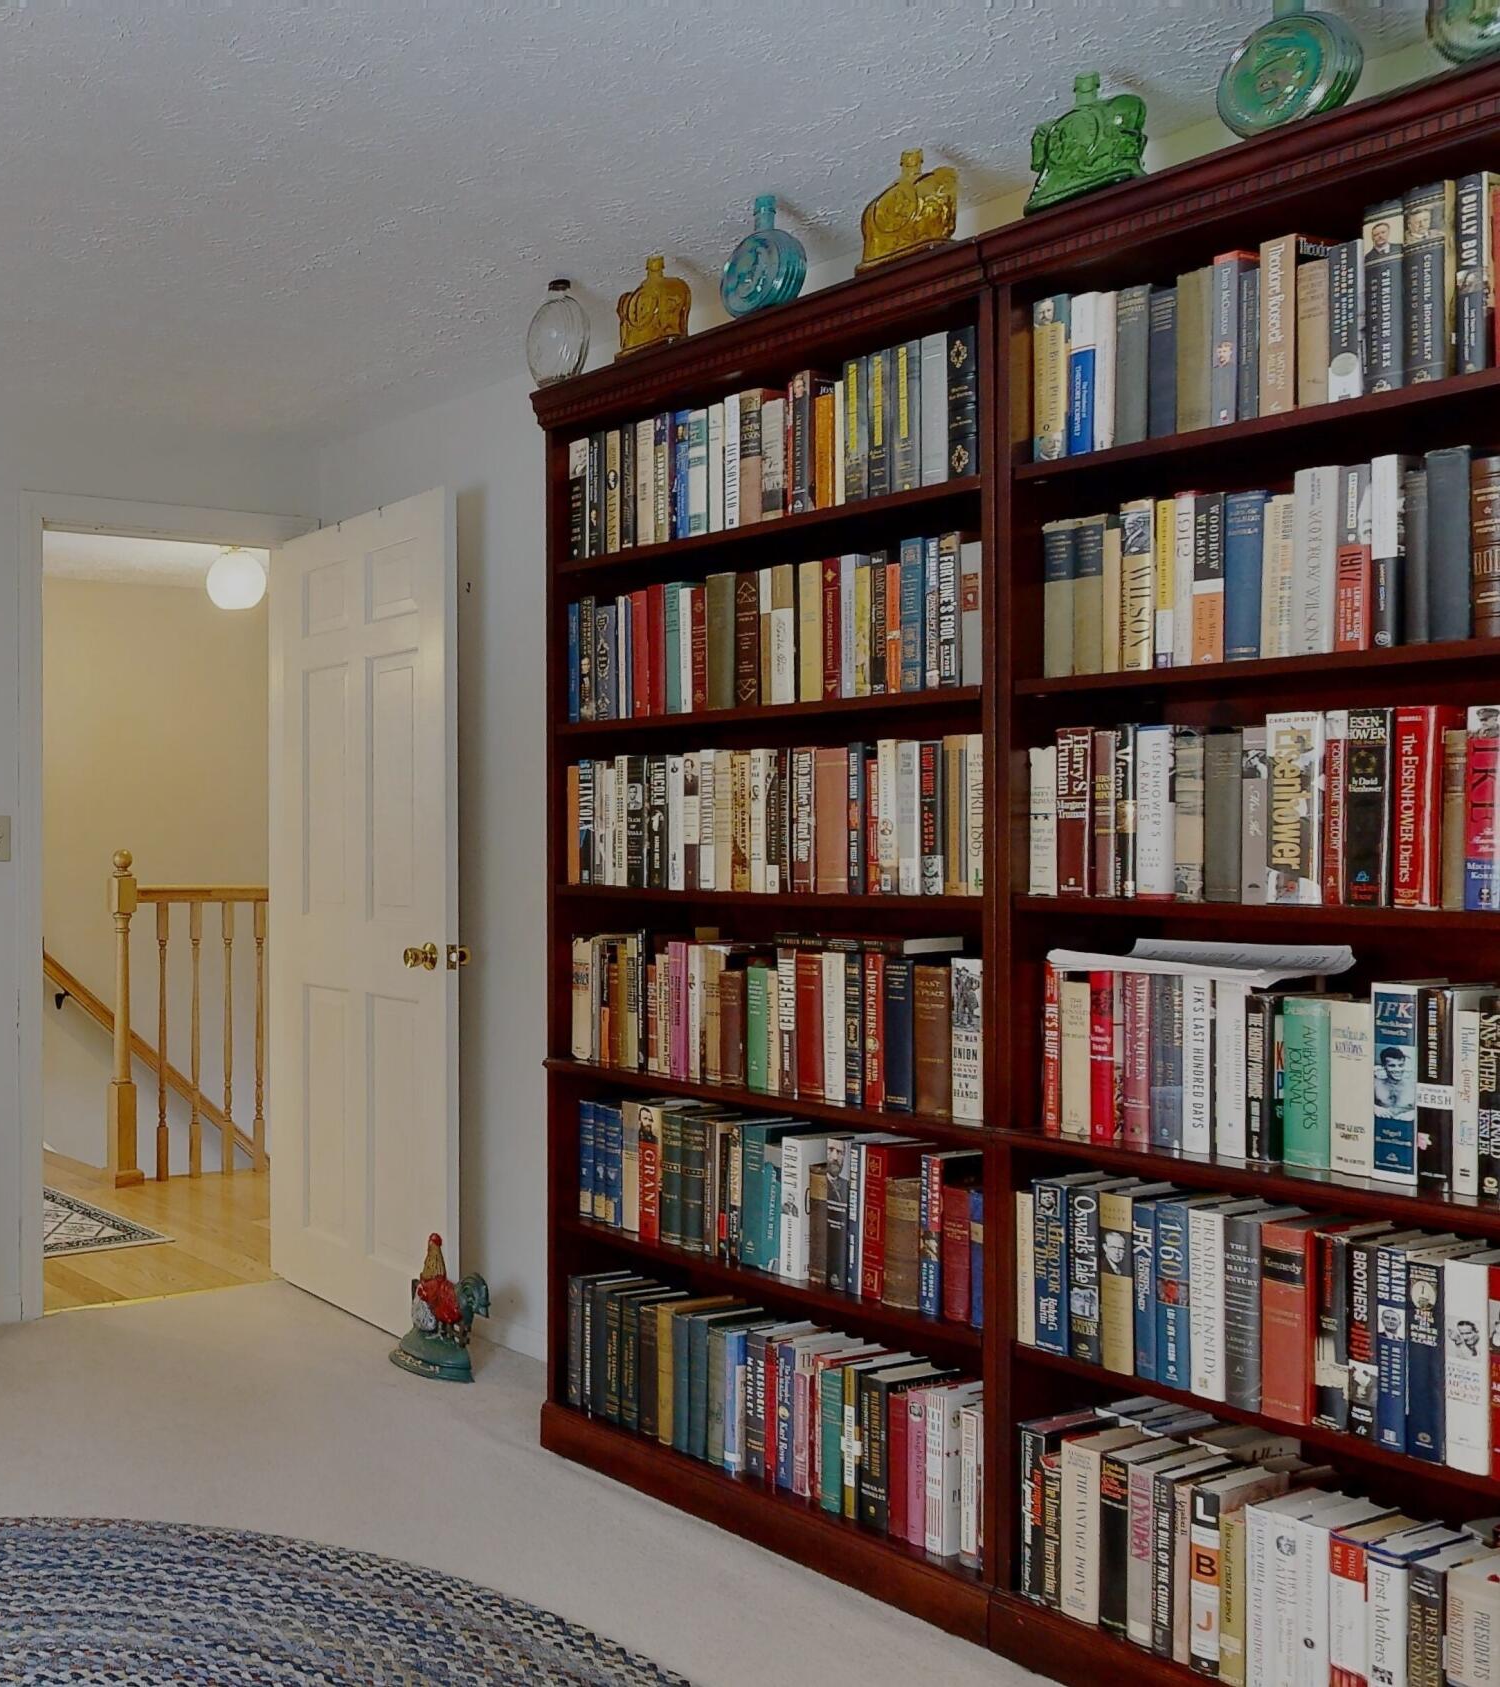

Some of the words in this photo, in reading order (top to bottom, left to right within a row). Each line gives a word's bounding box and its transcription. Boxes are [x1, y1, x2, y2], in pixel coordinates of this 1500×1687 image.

[1461, 193, 1477, 234] BULLY
[1461, 240, 1477, 266] BOY
[1196, 514, 1206, 564] WILSON
[1209, 504, 1220, 570] WOODROW
[940, 556, 955, 613] FORTUNE'S
[941, 615, 955, 643] FOOL
[798, 752, 811, 774] With
[1058, 734, 1073, 796] Truman
[1070, 734, 1088, 782] Harry
[1402, 733, 1417, 755] The
[653, 763, 666, 806] LINCOLN
[1271, 727, 1314, 872] Eisenhower
[1400, 756, 1419, 842] EISENHOWER
[1399, 845, 1414, 883] Diaries
[778, 958, 795, 1031] IMPEACHED
[866, 970, 878, 1035] IMPEACHERS
[1046, 1003, 1059, 1029] IKE'S
[1192, 986, 1205, 1013] JFK'S
[1045, 1030, 1059, 1060] BLUFF
[1192, 1017, 1205, 1042] LAST
[953, 1047, 978, 1061] UNION
[1192, 1047, 1204, 1098] HUNDRED
[1192, 1102, 1204, 1129] DAYS
[644, 1150, 655, 1217] GRANT
[784, 1145, 798, 1189] GRANT
[1074, 1195, 1097, 1254] Oswald's
[1133, 1221, 1152, 1257] JFK
[1159, 1221, 1184, 1276] 1960
[1203, 1218, 1216, 1303] PRESIDENT
[1074, 1256, 1098, 1285] Tale
[1353, 1250, 1367, 1322] BROTHERS
[1377, 1251, 1390, 1300] CHARGE
[1392, 1254, 1406, 1303] TAKING
[1203, 1305, 1216, 1379] KENNEDY
[756, 1359, 764, 1420] PRESIDENT
[779, 1421, 788, 1439] Karl
[1046, 1480, 1060, 1497] The
[1046, 1497, 1060, 1525] Limits
[1046, 1526, 1059, 1538] of
[1158, 1510, 1170, 1529] THE
[1158, 1529, 1169, 1550] BILL
[1158, 1551, 1169, 1565] OF
[1045, 1538, 1059, 1594] Intervention
[1158, 1566, 1168, 1584] THE
[1374, 1568, 1391, 1601] First
[1157, 1585, 1168, 1625] CENTURY
[1373, 1603, 1391, 1664] Mothers
[1425, 1607, 1438, 1687] PRESIDENT
[1473, 1610, 1490, 1681] PRESIDENTS
